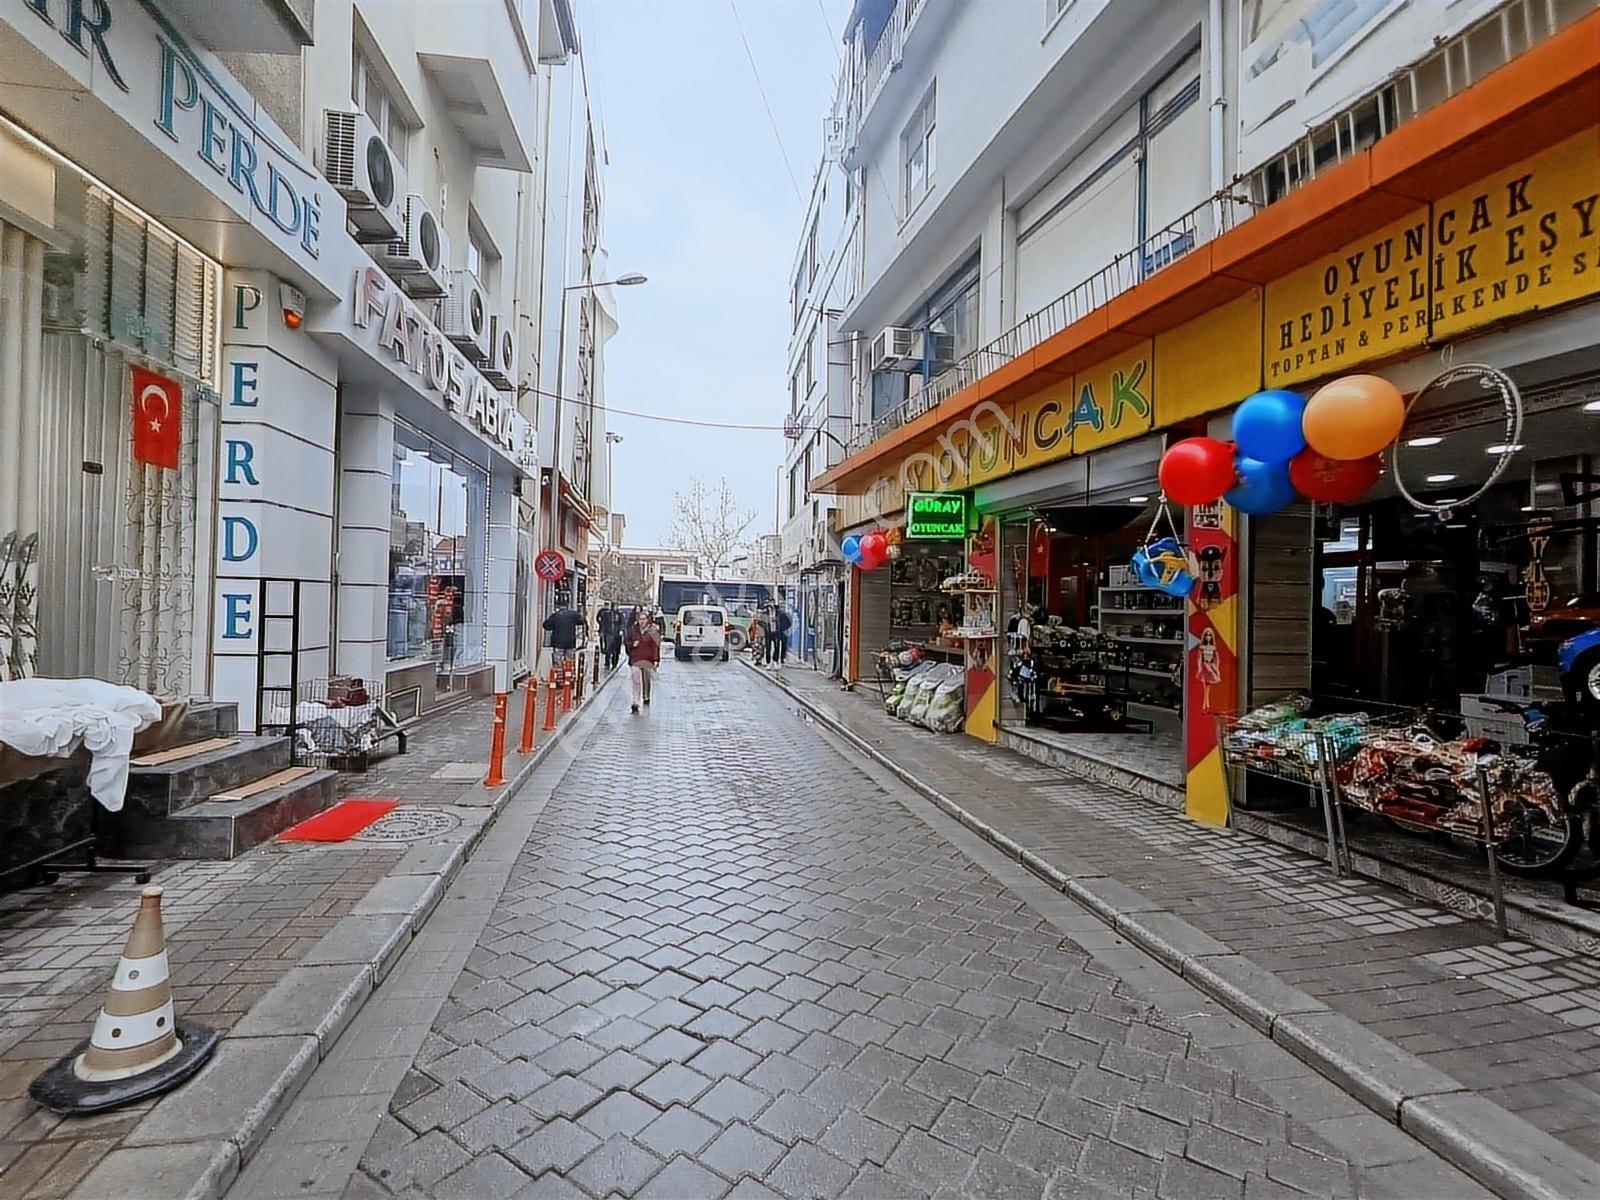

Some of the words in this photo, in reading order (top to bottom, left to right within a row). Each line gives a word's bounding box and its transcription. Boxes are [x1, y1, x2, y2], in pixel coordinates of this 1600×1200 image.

[1324, 174, 1533, 296] OYUNCAK
[1270, 338, 1346, 377] TOPTAN
[1358, 330, 1370, 347] &
[1382, 264, 1552, 339] PERAKENDE
[1573, 247, 1600, 275] S
[1279, 244, 1478, 351] HEDİYELİK
[222, 285, 263, 639] PERDE
[938, 360, 1149, 484] OYUNCAK
[912, 523, 964, 533] OYUNCAK
